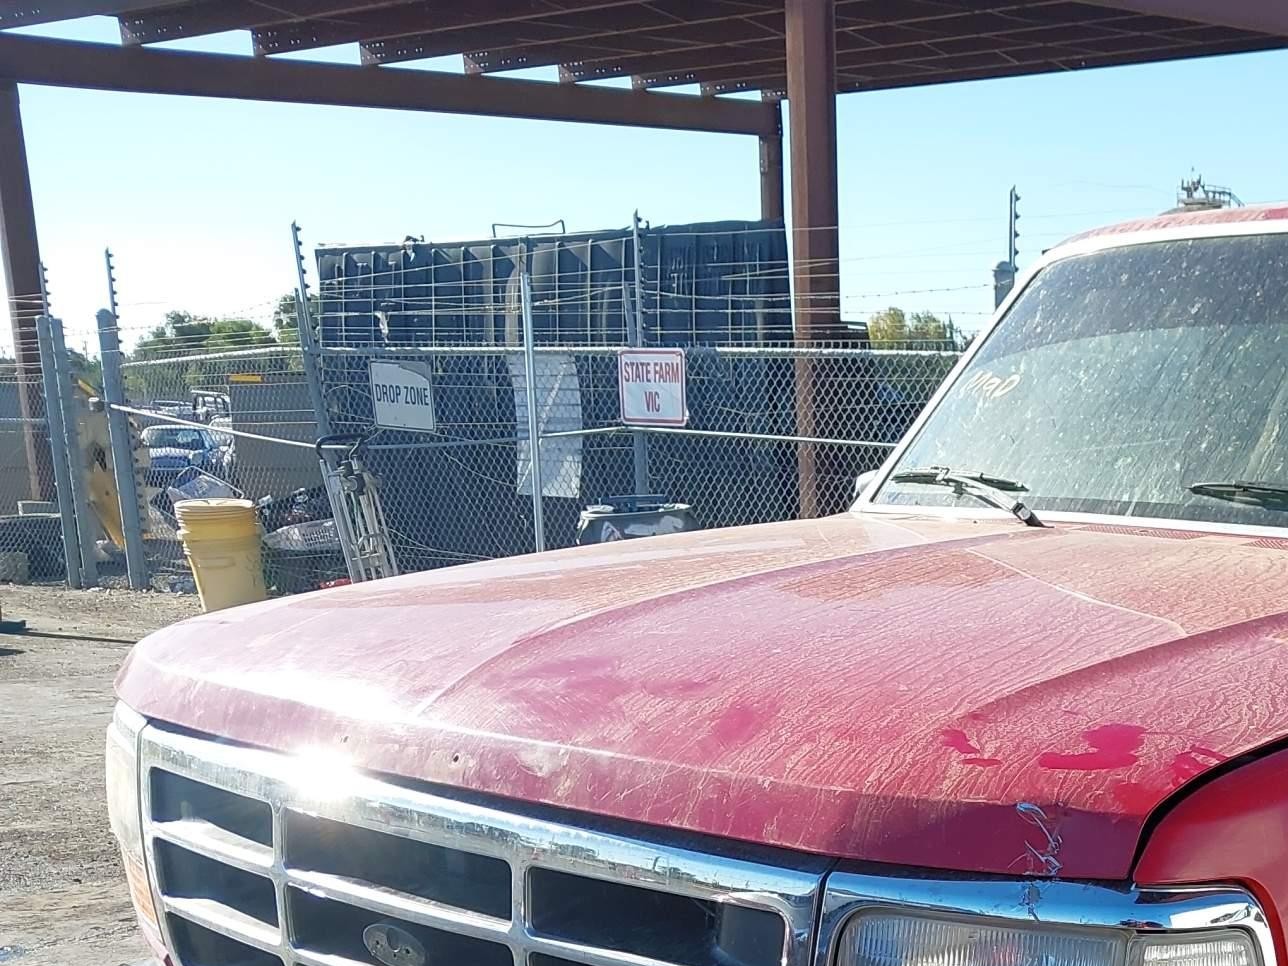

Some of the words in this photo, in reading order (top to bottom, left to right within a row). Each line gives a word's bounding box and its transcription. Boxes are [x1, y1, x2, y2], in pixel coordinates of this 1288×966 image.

[623, 361, 651, 383] STATE
[653, 362, 680, 384] FARM
[375, 383, 401, 404] DROP
[404, 385, 430, 407] ZONE
[644, 391, 661, 413] VIC
